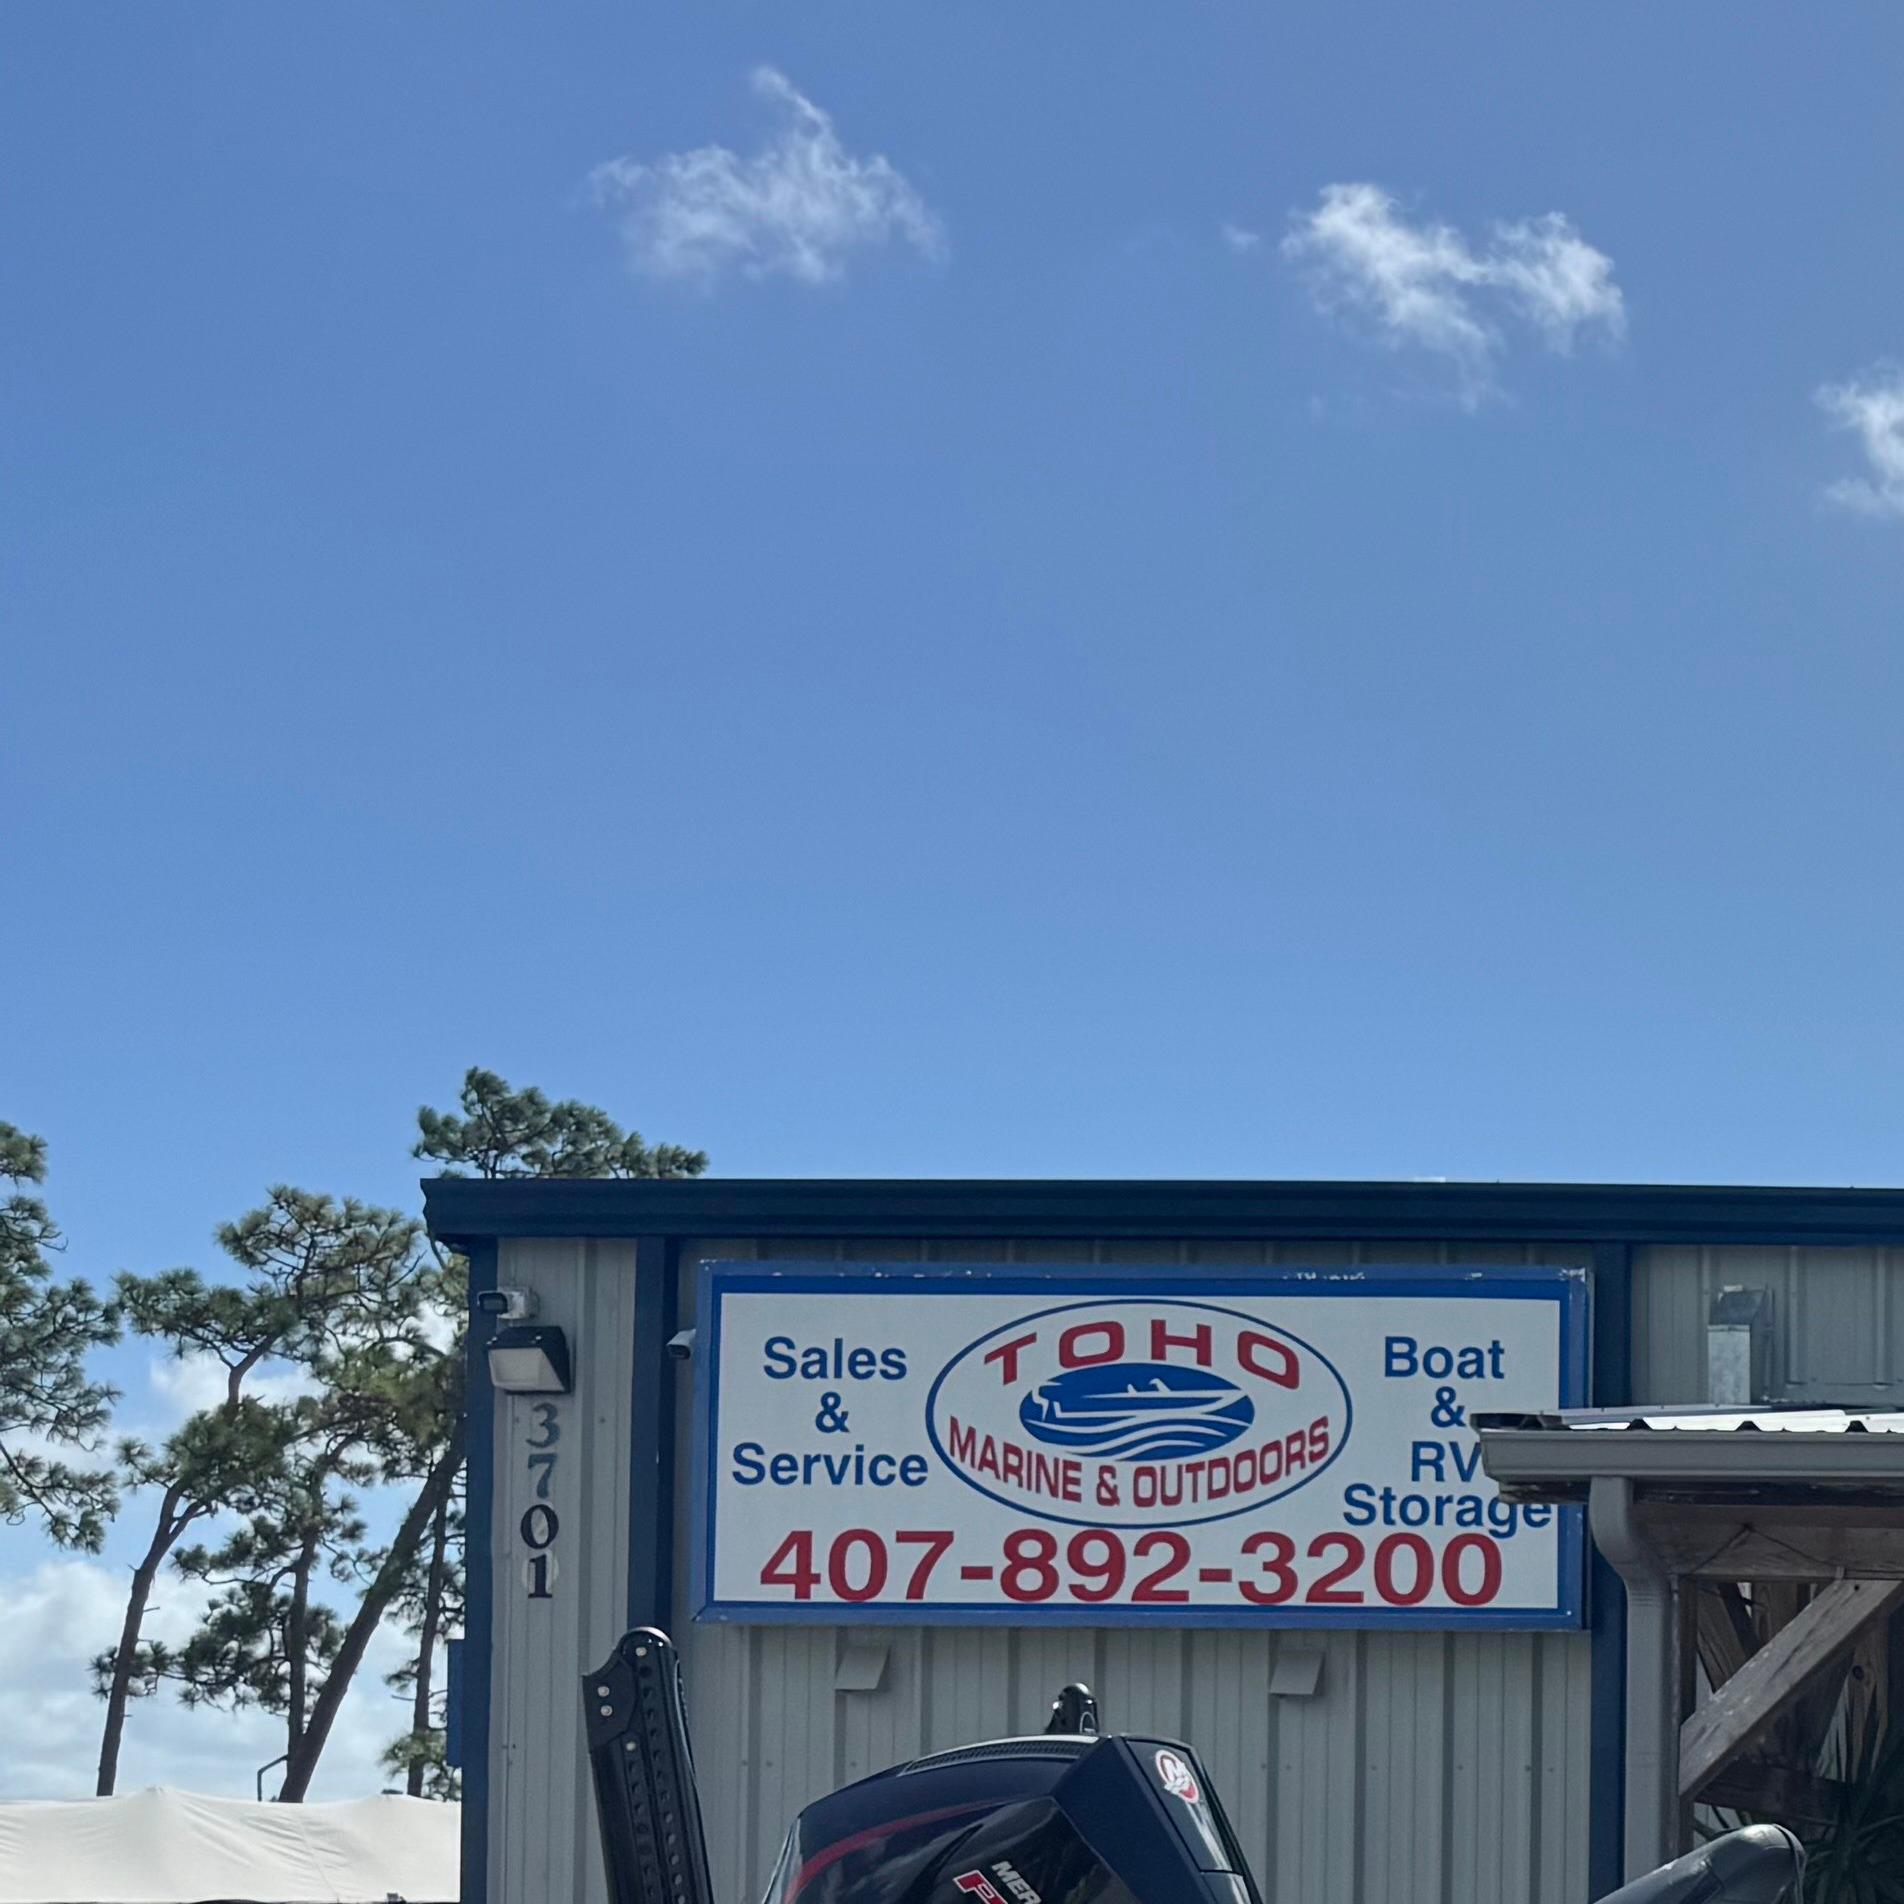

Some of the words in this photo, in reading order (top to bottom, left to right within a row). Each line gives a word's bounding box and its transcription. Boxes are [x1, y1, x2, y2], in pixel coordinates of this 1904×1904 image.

[763, 1336, 907, 1381] Sales
[984, 1319, 1300, 1390] TOHO
[1384, 1336, 1505, 1379] Boat
[815, 1391, 850, 1434] &
[1430, 1386, 1466, 1428] &
[732, 1442, 928, 1487] Service
[949, 1415, 1083, 1503] MARINE
[1096, 1465, 1120, 1507] &
[1132, 1415, 1329, 1508] OUTDOORS
[1411, 1441, 1482, 1482] RV
[520, 1403, 560, 1599] 3701
[1343, 1483, 1552, 1539] Storage
[759, 1528, 1503, 1606] 407-892-3200
